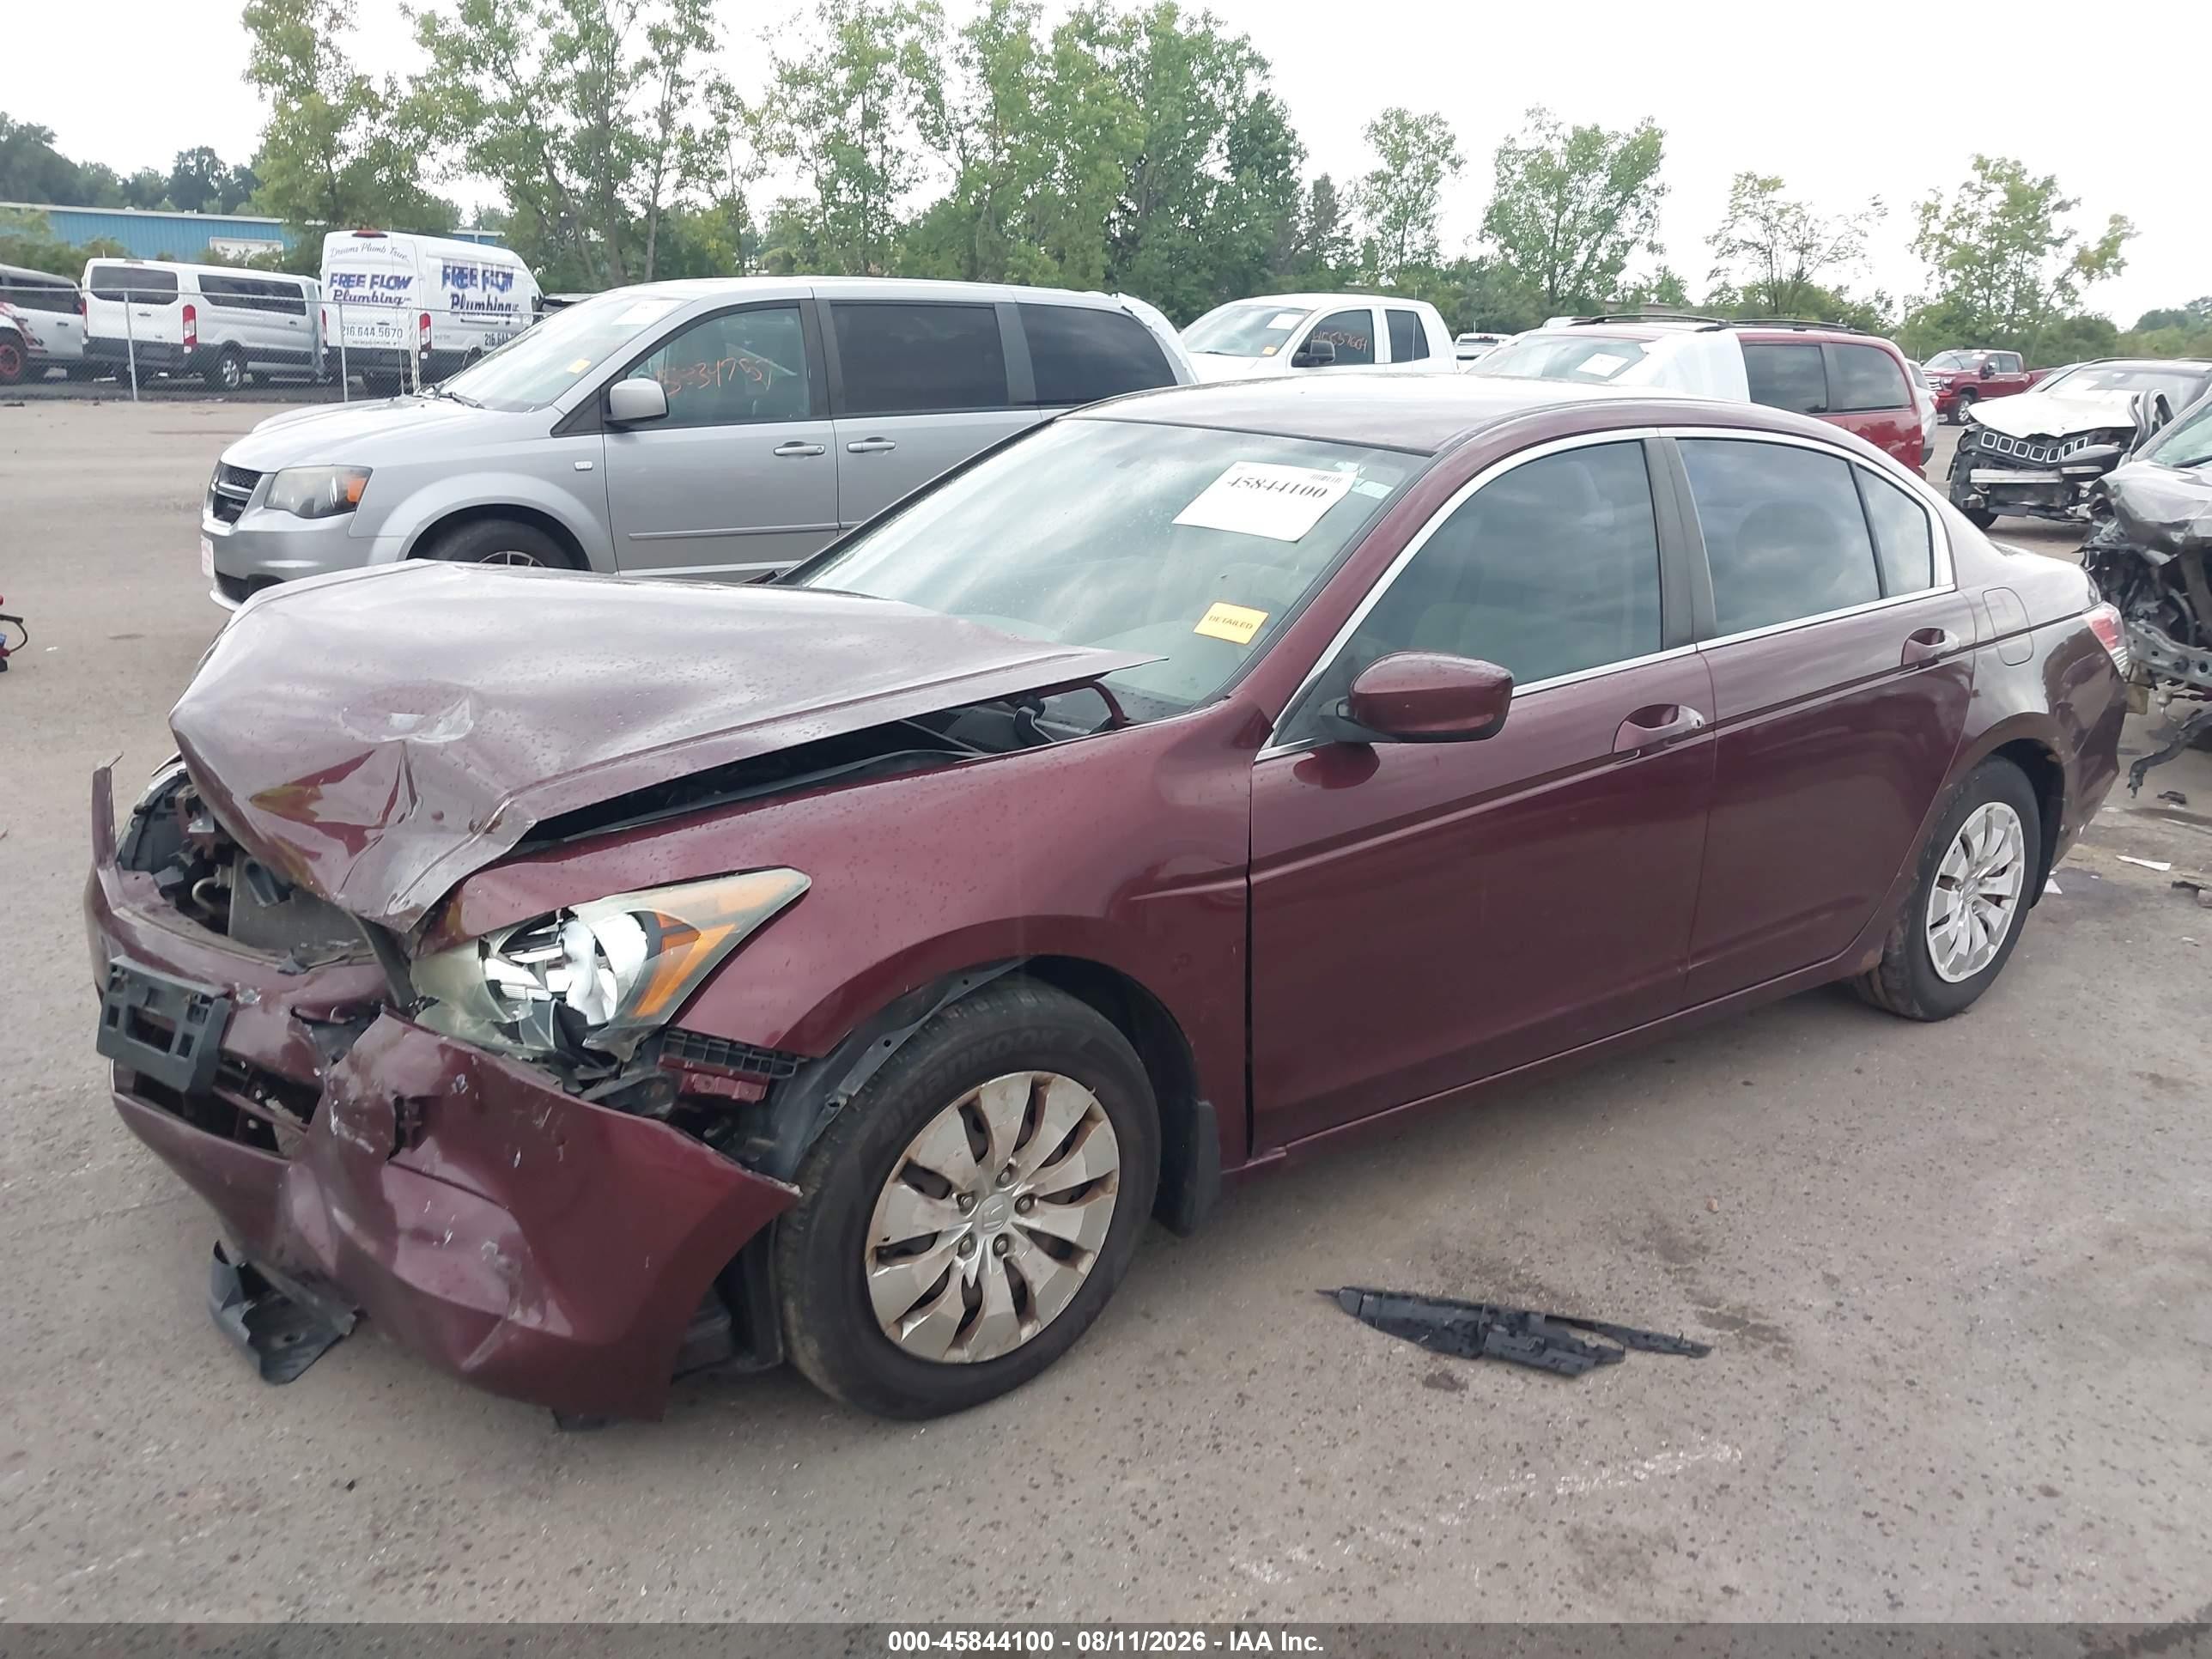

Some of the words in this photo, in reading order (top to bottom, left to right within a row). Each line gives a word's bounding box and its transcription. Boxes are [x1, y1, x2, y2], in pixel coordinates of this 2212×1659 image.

[361, 242, 386, 254] Plumb
[329, 272, 367, 289] FREE
[369, 273, 413, 290] FLOW
[441, 259, 478, 290] FREE
[482, 264, 514, 293] FLOW
[332, 289, 404, 305] Plumbing
[450, 293, 512, 317] Plumbing
[1226, 475, 1328, 499] 45844100
[1208, 615, 1254, 630] DETAILED
